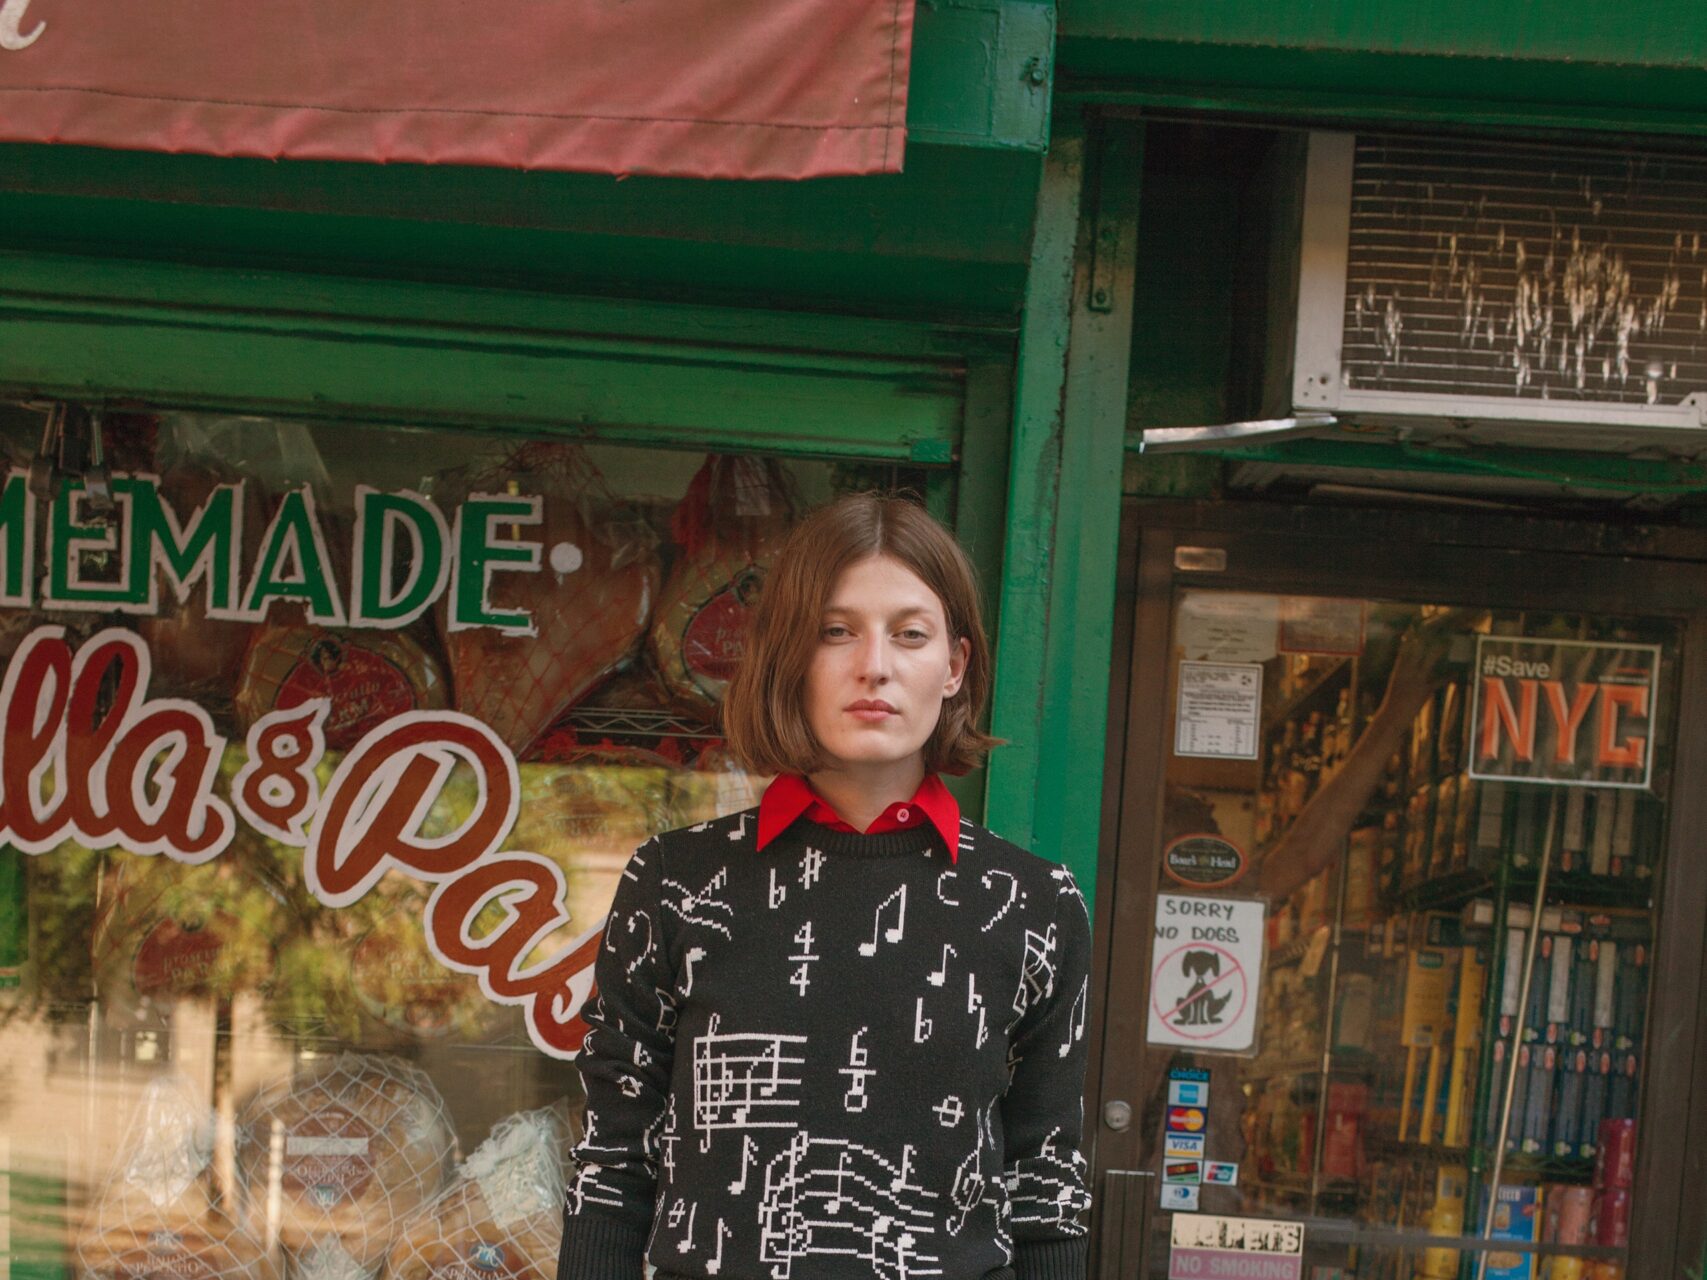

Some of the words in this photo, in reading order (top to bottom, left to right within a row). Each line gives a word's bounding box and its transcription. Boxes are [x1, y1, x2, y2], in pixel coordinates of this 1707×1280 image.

[1483, 655, 1550, 678] #Save
[1481, 677, 1649, 768] NYC
[1165, 898, 1234, 921] SORRY
[1155, 926, 1179, 940] NO
[1191, 926, 1240, 943] DOGS
[1172, 1140, 1198, 1151] VISA
[1176, 1255, 1202, 1273] NO
[1210, 1257, 1294, 1278] SMOKING
